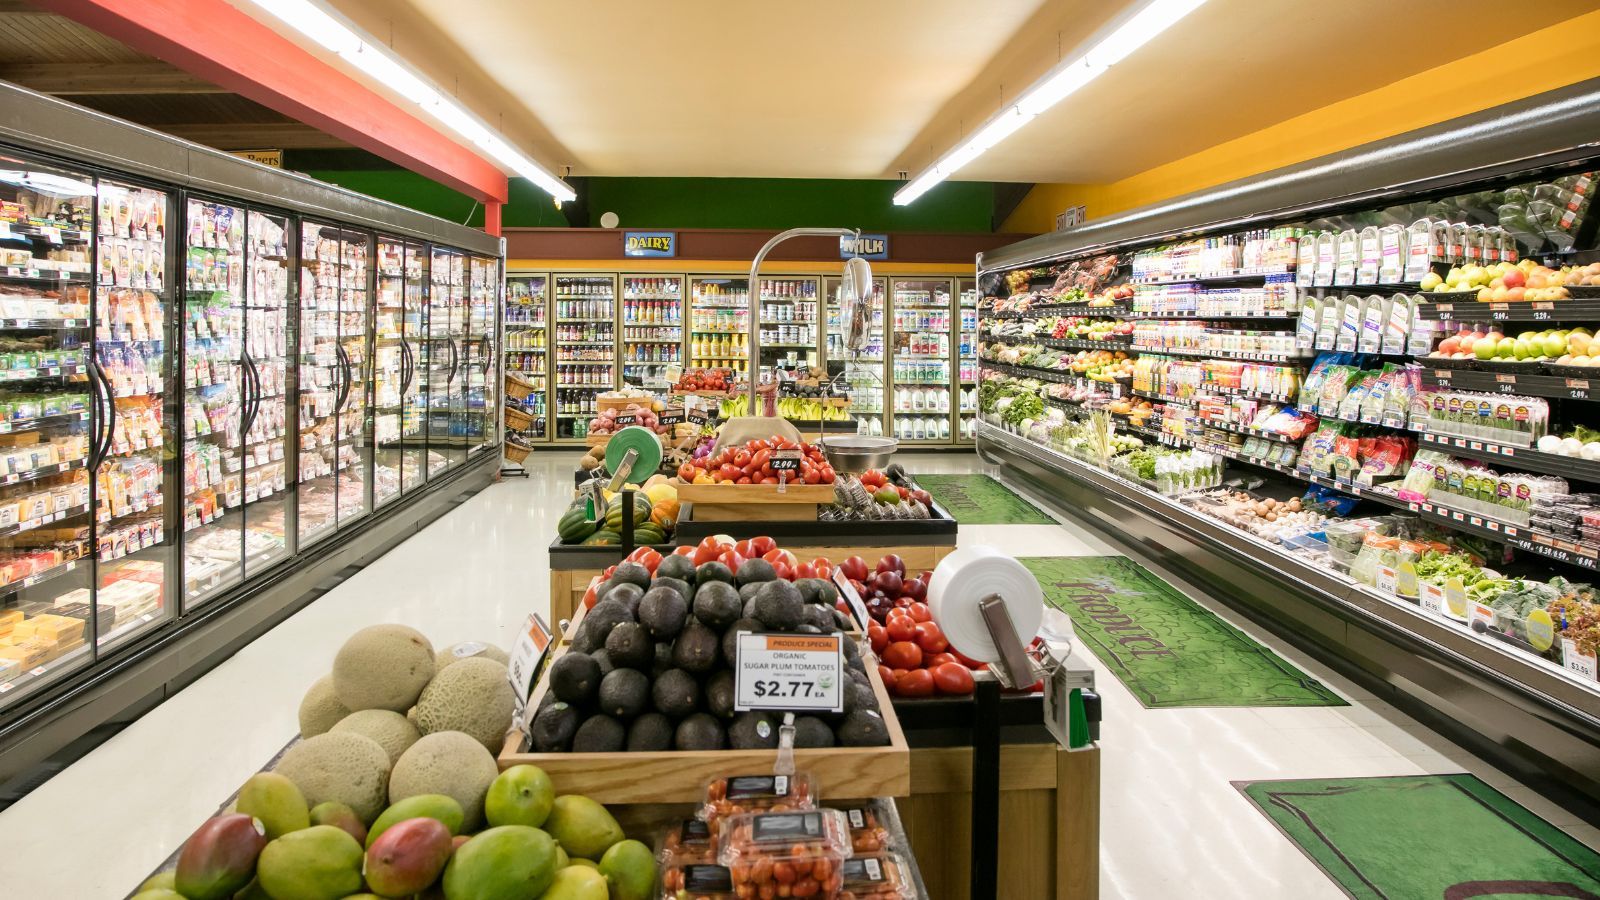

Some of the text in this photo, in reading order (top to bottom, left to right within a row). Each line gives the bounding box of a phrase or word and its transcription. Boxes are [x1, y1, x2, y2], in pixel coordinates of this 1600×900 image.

[628, 236, 671, 251] DAIRY
[843, 238, 884, 254] MILK
[773, 640, 804, 648] PRODUCE
[772, 652, 807, 660] ORGANIC
[744, 662, 835, 671] SUGAR PLUM TOMATOES
[753, 680, 814, 698] $2.77
